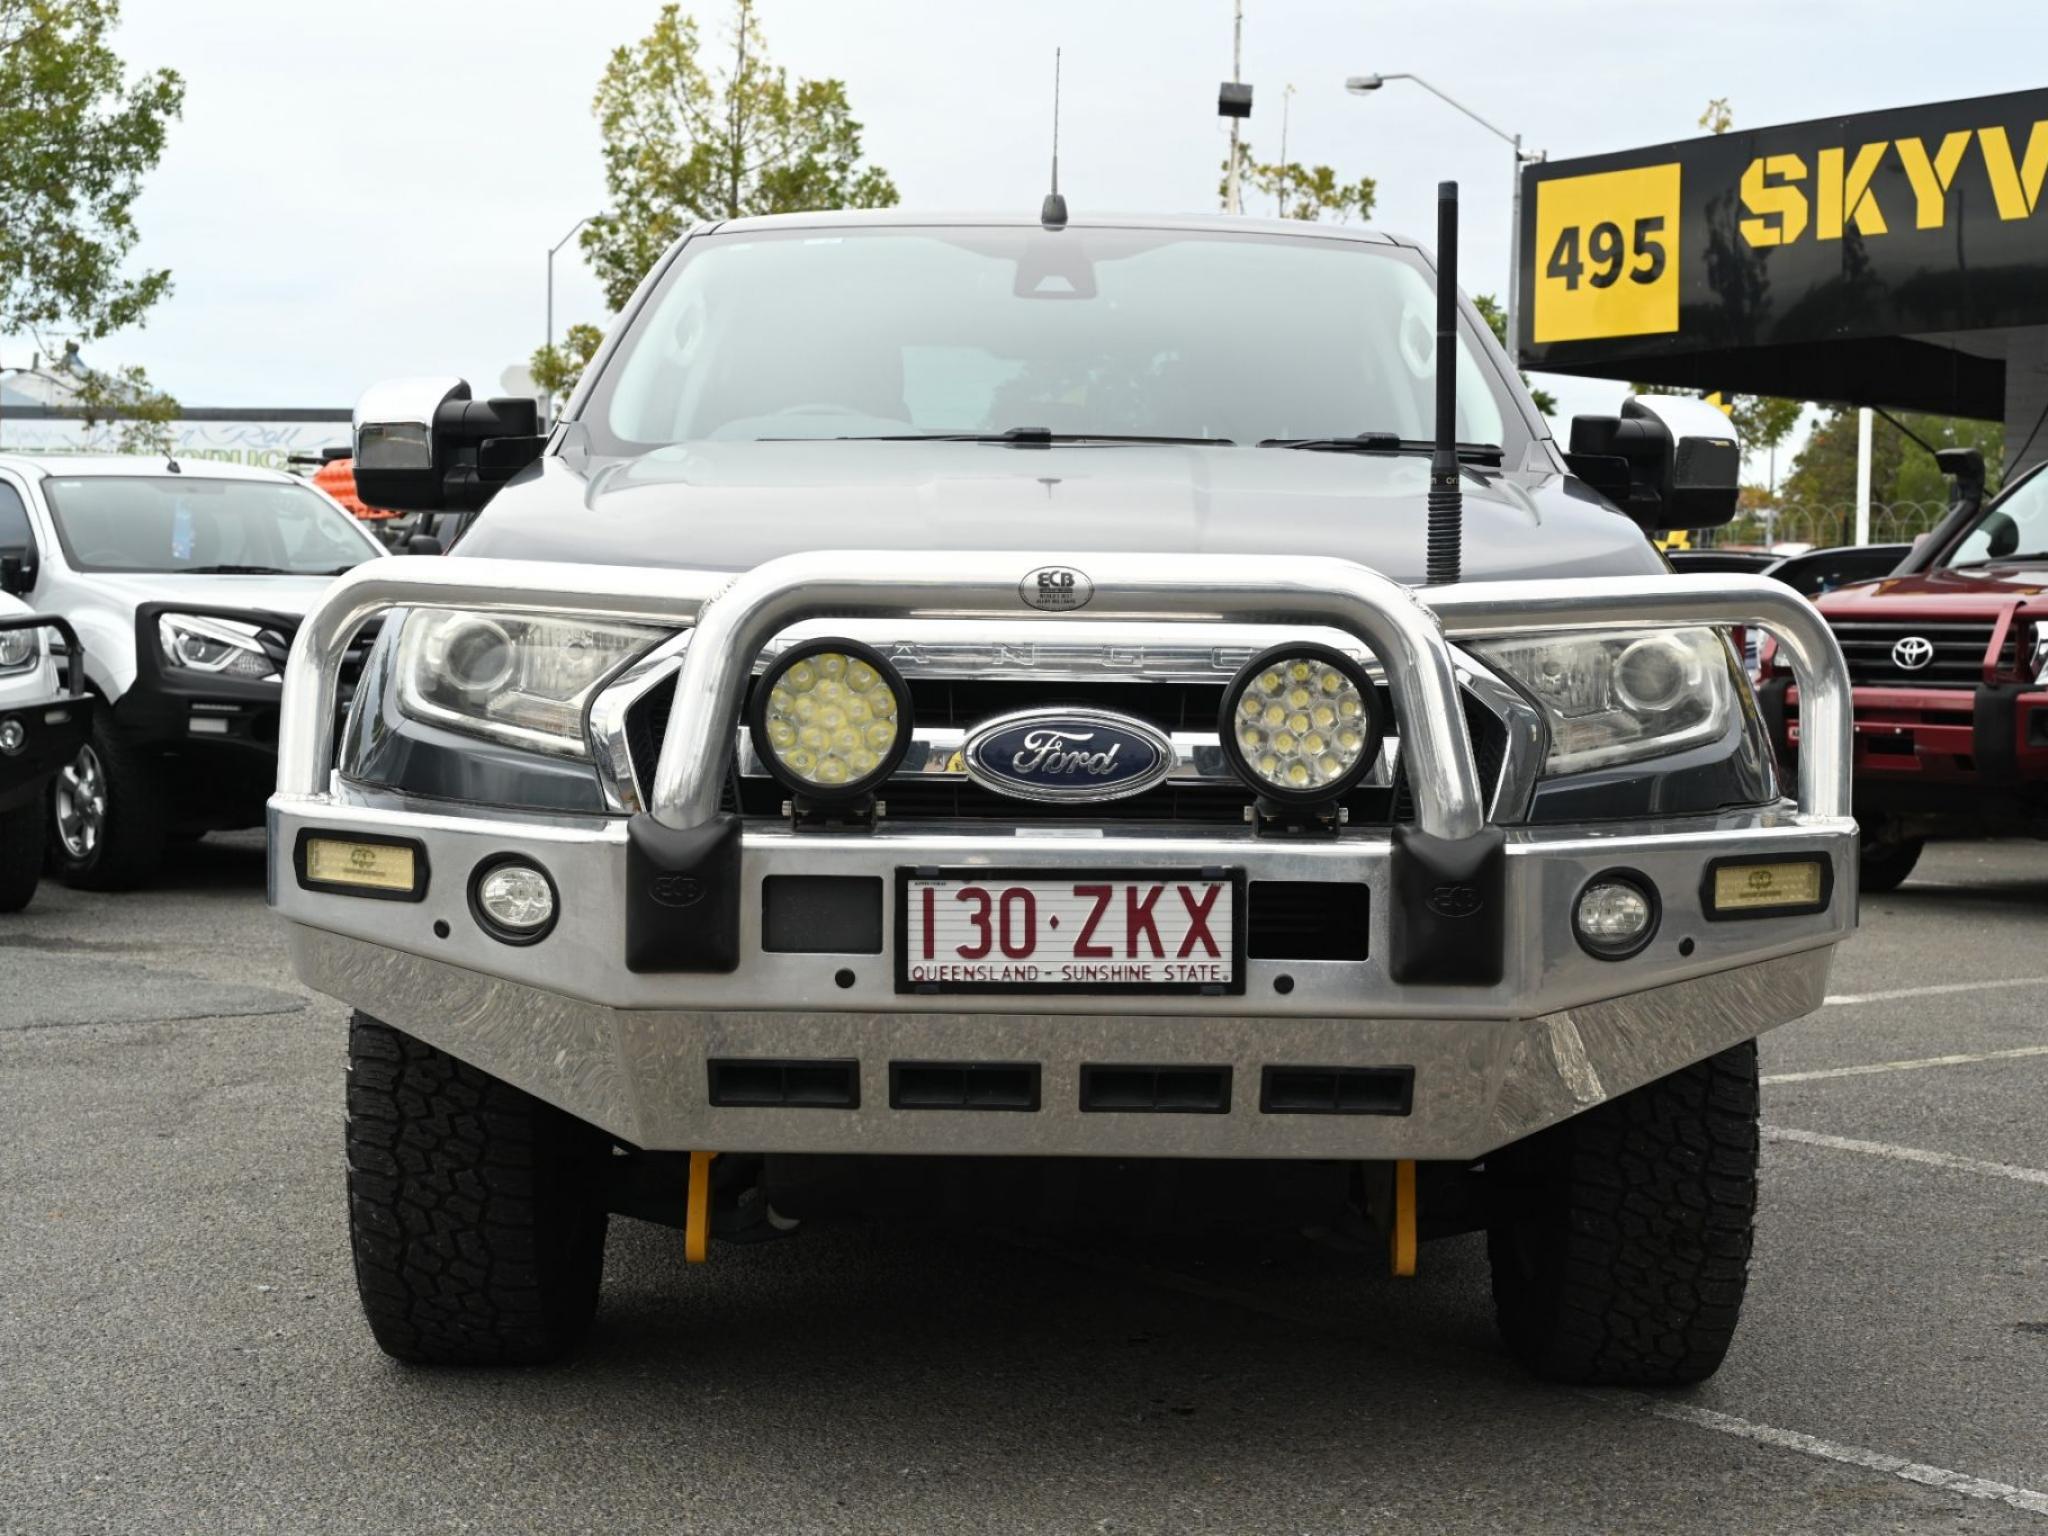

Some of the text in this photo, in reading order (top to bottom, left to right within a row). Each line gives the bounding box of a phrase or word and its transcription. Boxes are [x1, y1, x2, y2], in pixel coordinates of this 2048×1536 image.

[1545, 215, 1666, 291] 495
[1038, 570, 1075, 587] ECB
[1012, 729, 1121, 774] Ford
[912, 965, 1038, 981] QUEENSLAND
[1062, 964, 1151, 981] SUNSHINE
[1164, 964, 1221, 981] STATE
